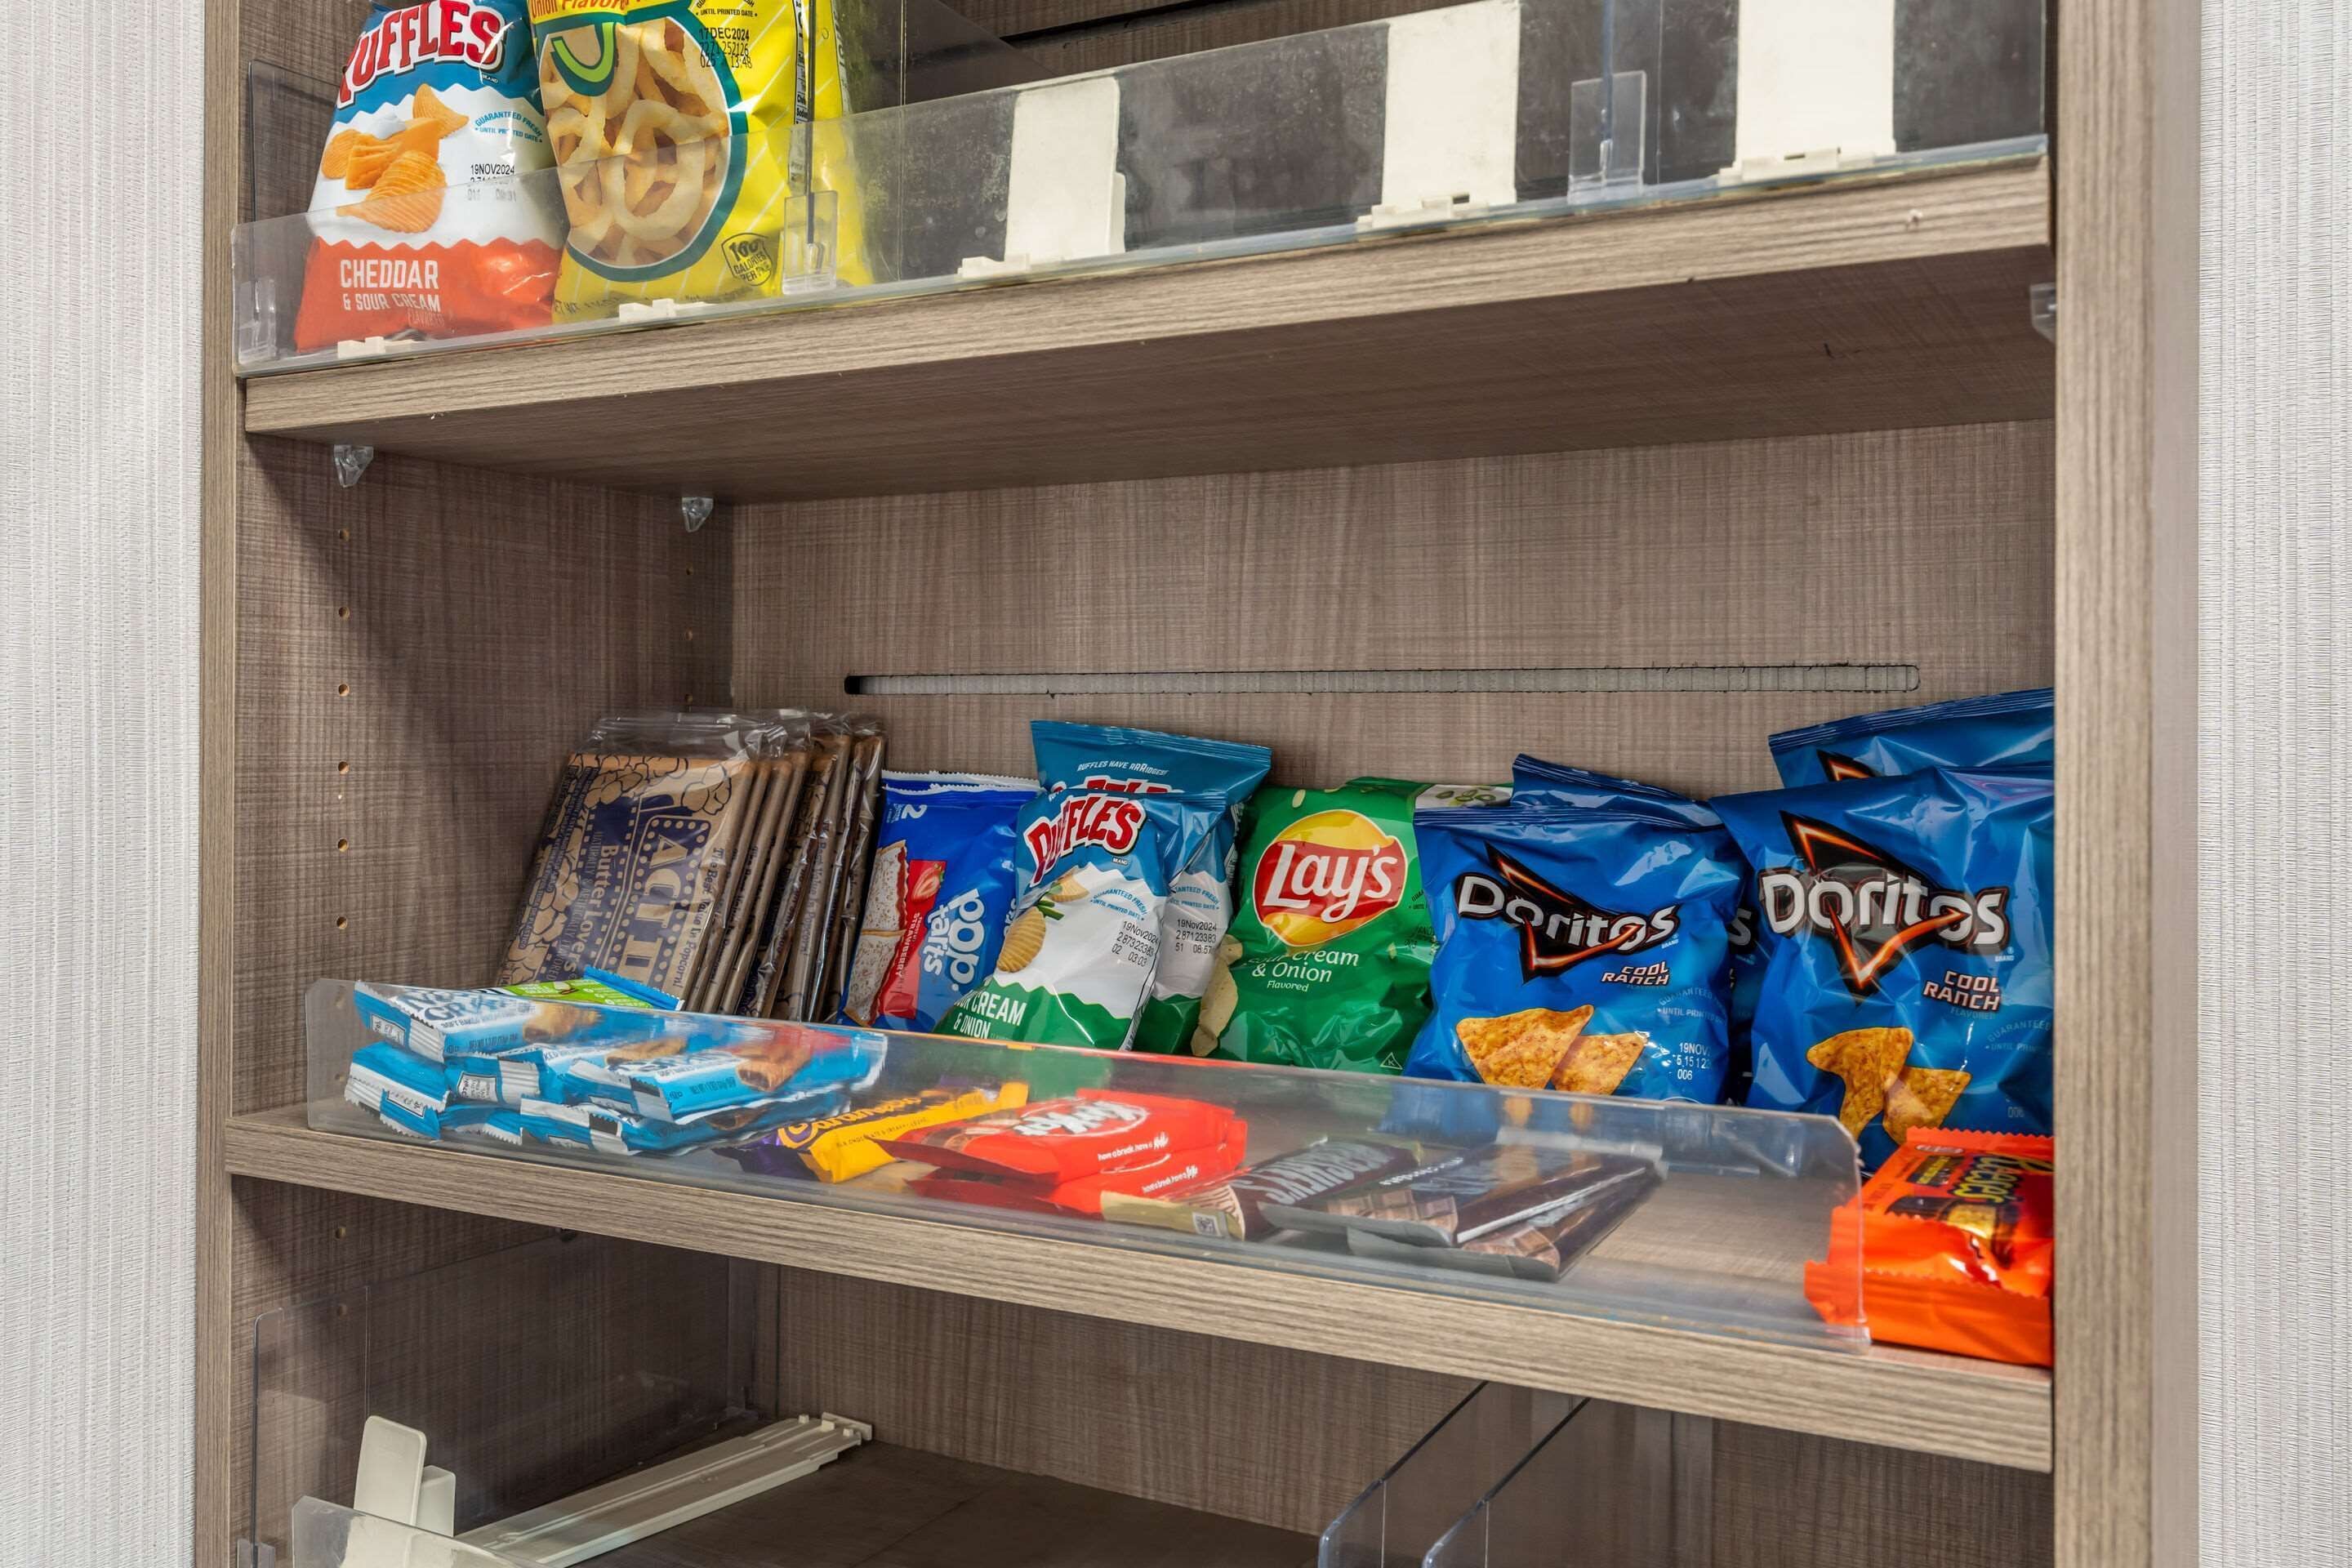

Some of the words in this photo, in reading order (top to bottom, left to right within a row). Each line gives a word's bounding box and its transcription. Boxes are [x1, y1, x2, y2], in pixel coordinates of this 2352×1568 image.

[699, 27, 750, 42] 17DEC2024
[498, 128, 523, 138] PRTED
[470, 163, 514, 176] 19NOV2024
[341, 259, 439, 289] CHEDDAR
[343, 293, 351, 310] &
[355, 293, 390, 310] SOUR
[392, 292, 441, 312] CREAM
[1077, 760, 1107, 772] RUFFLES
[1108, 760, 1128, 770] HAVE
[901, 804, 928, 819] 2
[588, 845, 619, 908] Butter
[635, 834, 688, 929] ACT
[702, 868, 719, 896] Best
[1262, 843, 1399, 924] Lay's
[1176, 886, 1201, 894] ANTEED
[693, 899, 713, 925] Value
[1458, 876, 1679, 951] Doritos
[1762, 872, 2006, 946] Doritos
[690, 927, 702, 938] In
[946, 889, 985, 984] pop
[1123, 920, 1159, 944] 19Nov2024
[1177, 919, 1217, 932] 19Nov2024
[564, 911, 604, 973] Lovers
[896, 912, 920, 978] STRAWBERRY
[923, 904, 951, 975] tarts
[1111, 943, 1122, 955] 02
[1176, 942, 1183, 952] 51
[673, 940, 697, 989] Popcorn!
[1251, 964, 1267, 978] &
[1272, 961, 1332, 982] Onion
[1621, 961, 1669, 977] COOL
[1267, 980, 1309, 992] Flavored
[1601, 972, 1669, 985] RANCH
[1944, 970, 1999, 993] COOL
[1923, 981, 2000, 1010] RANCH
[971, 991, 1027, 1027] CREAM
[1662, 1007, 1685, 1016] UNTIL
[953, 1012, 963, 1031] &
[960, 1014, 991, 1040] ONION
[1677, 1068, 1693, 1080] 006
